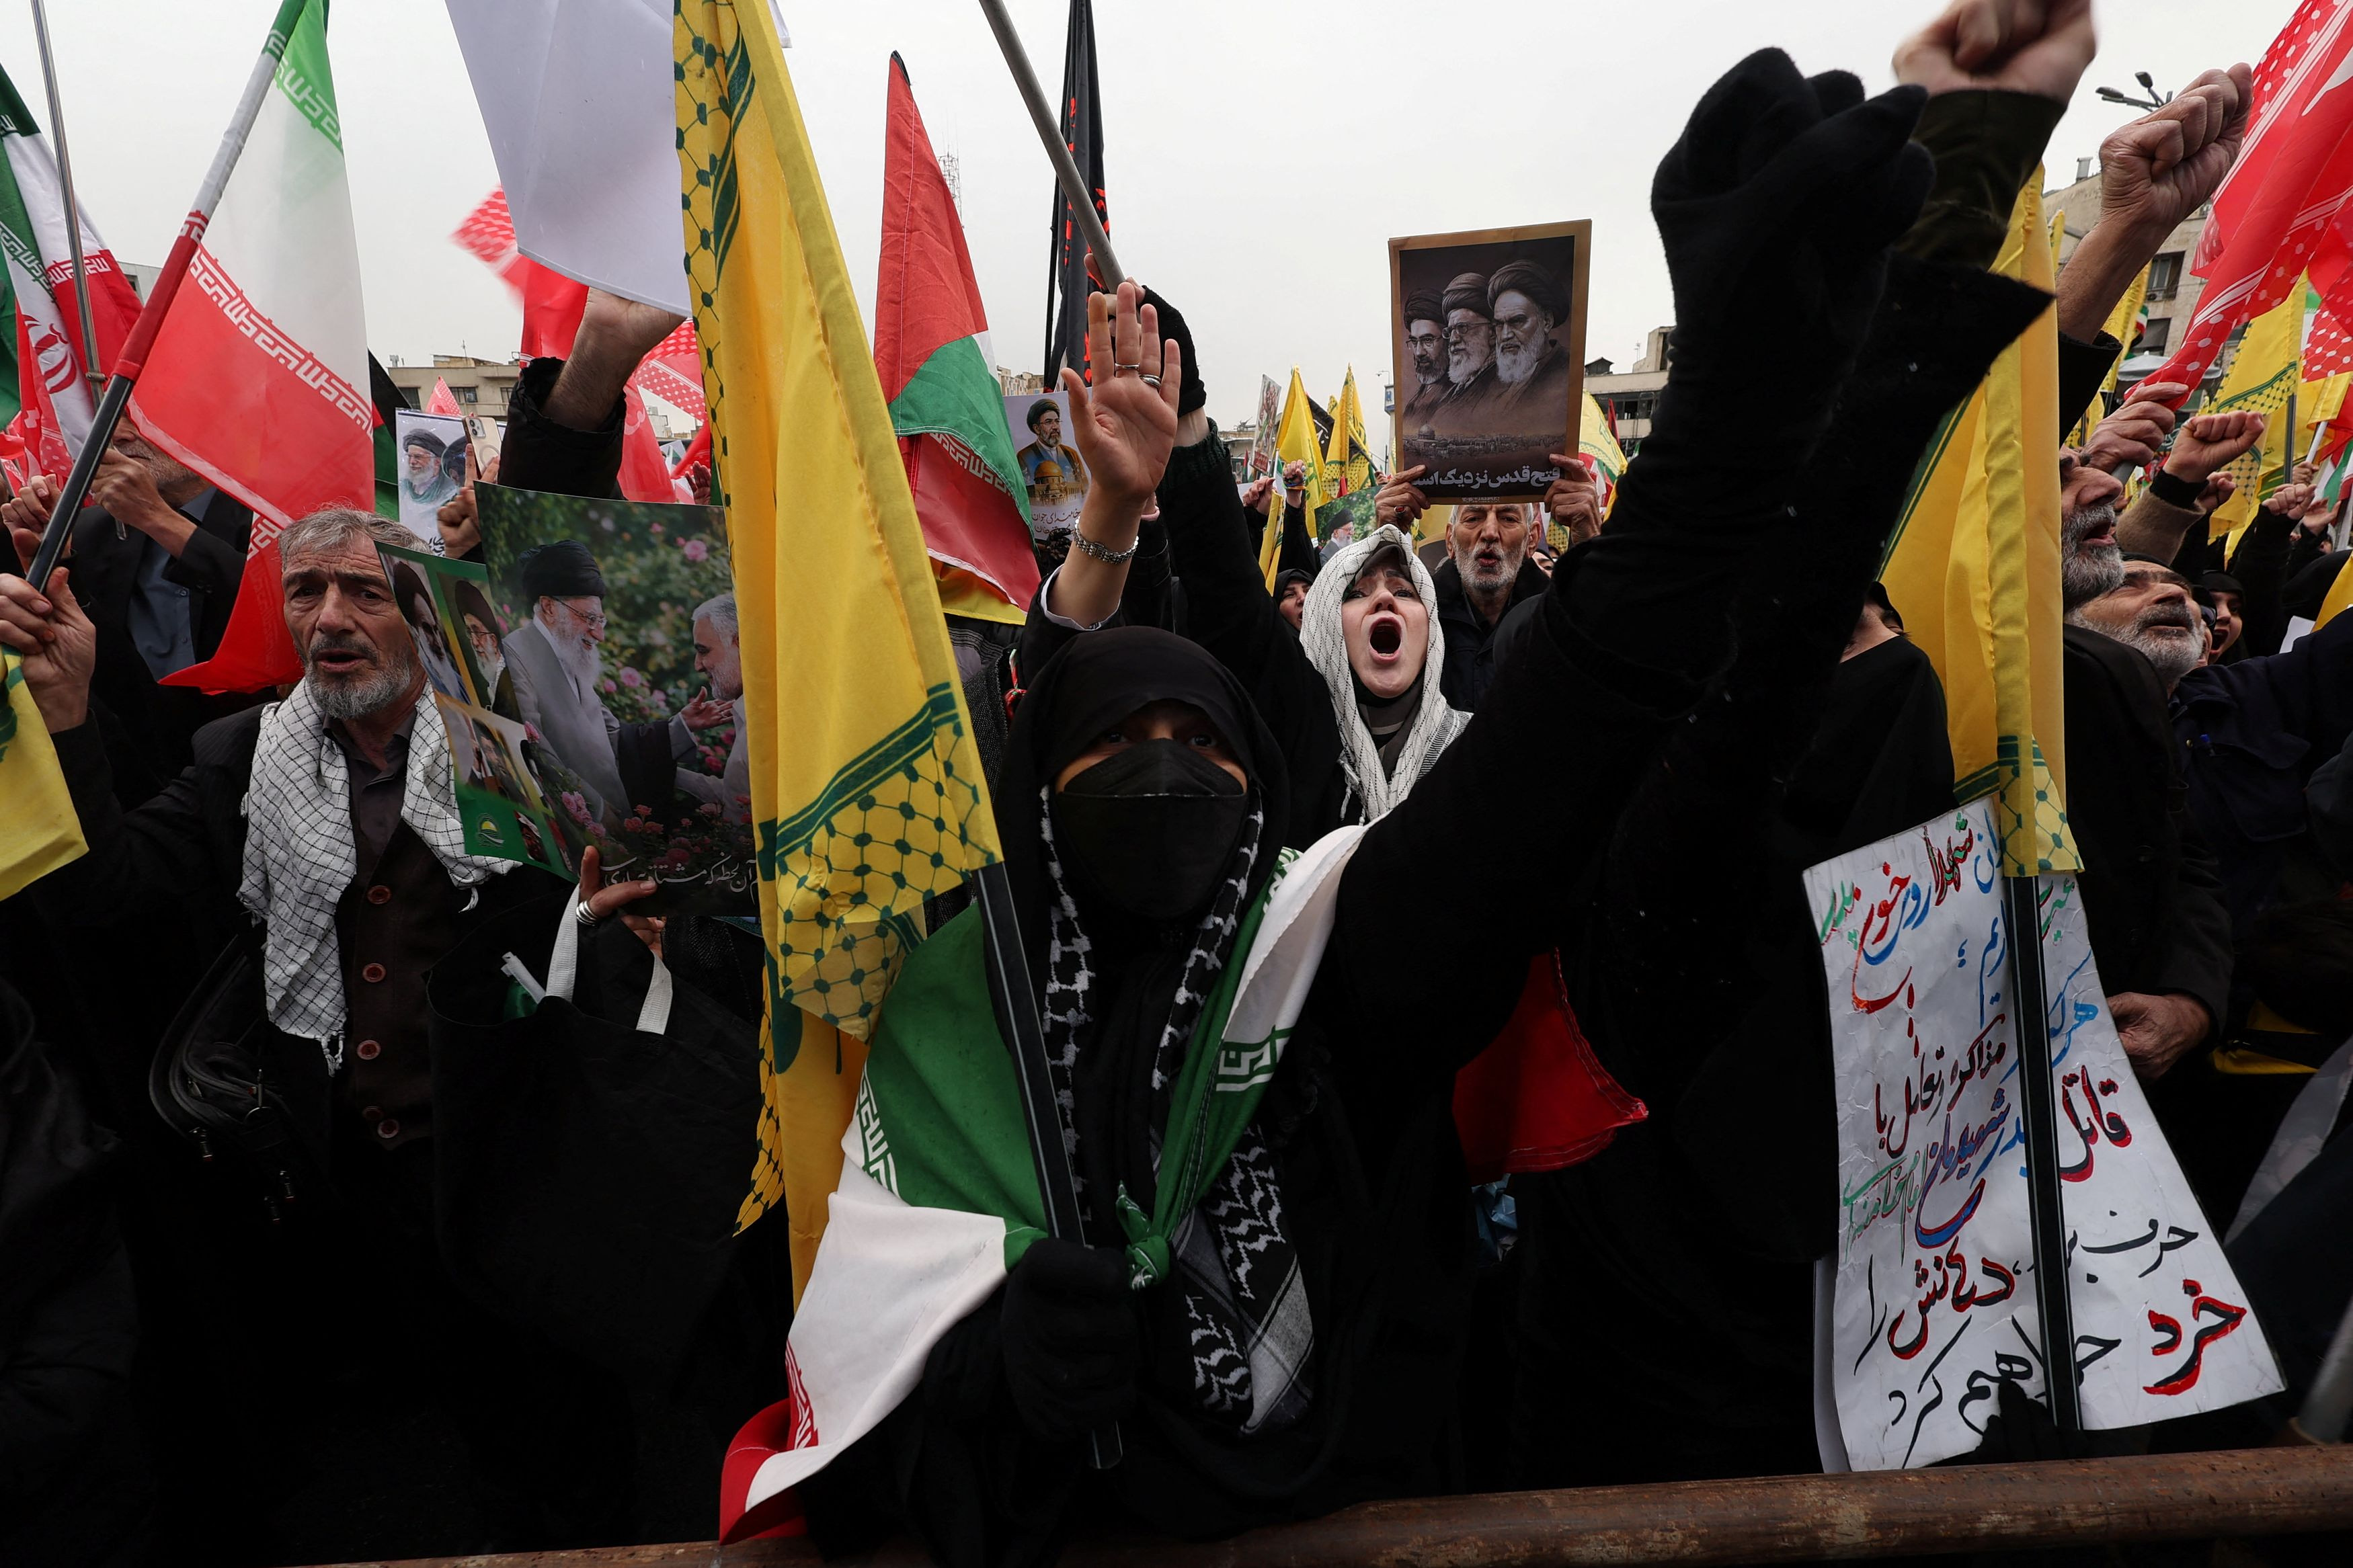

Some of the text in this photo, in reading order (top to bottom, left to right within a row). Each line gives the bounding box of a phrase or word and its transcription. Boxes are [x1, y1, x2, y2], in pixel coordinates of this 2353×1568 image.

[1031, 513, 1047, 524] جوان
[1412, 465, 1561, 490] فتح قدس نزدیک اس
[2059, 1064, 2133, 1184] قاتل
[2081, 1209, 2199, 1278] حرف
[1853, 1253, 1887, 1376] را
[2142, 1279, 2248, 1395] خرد
[1887, 1314, 1972, 1469] کرد
